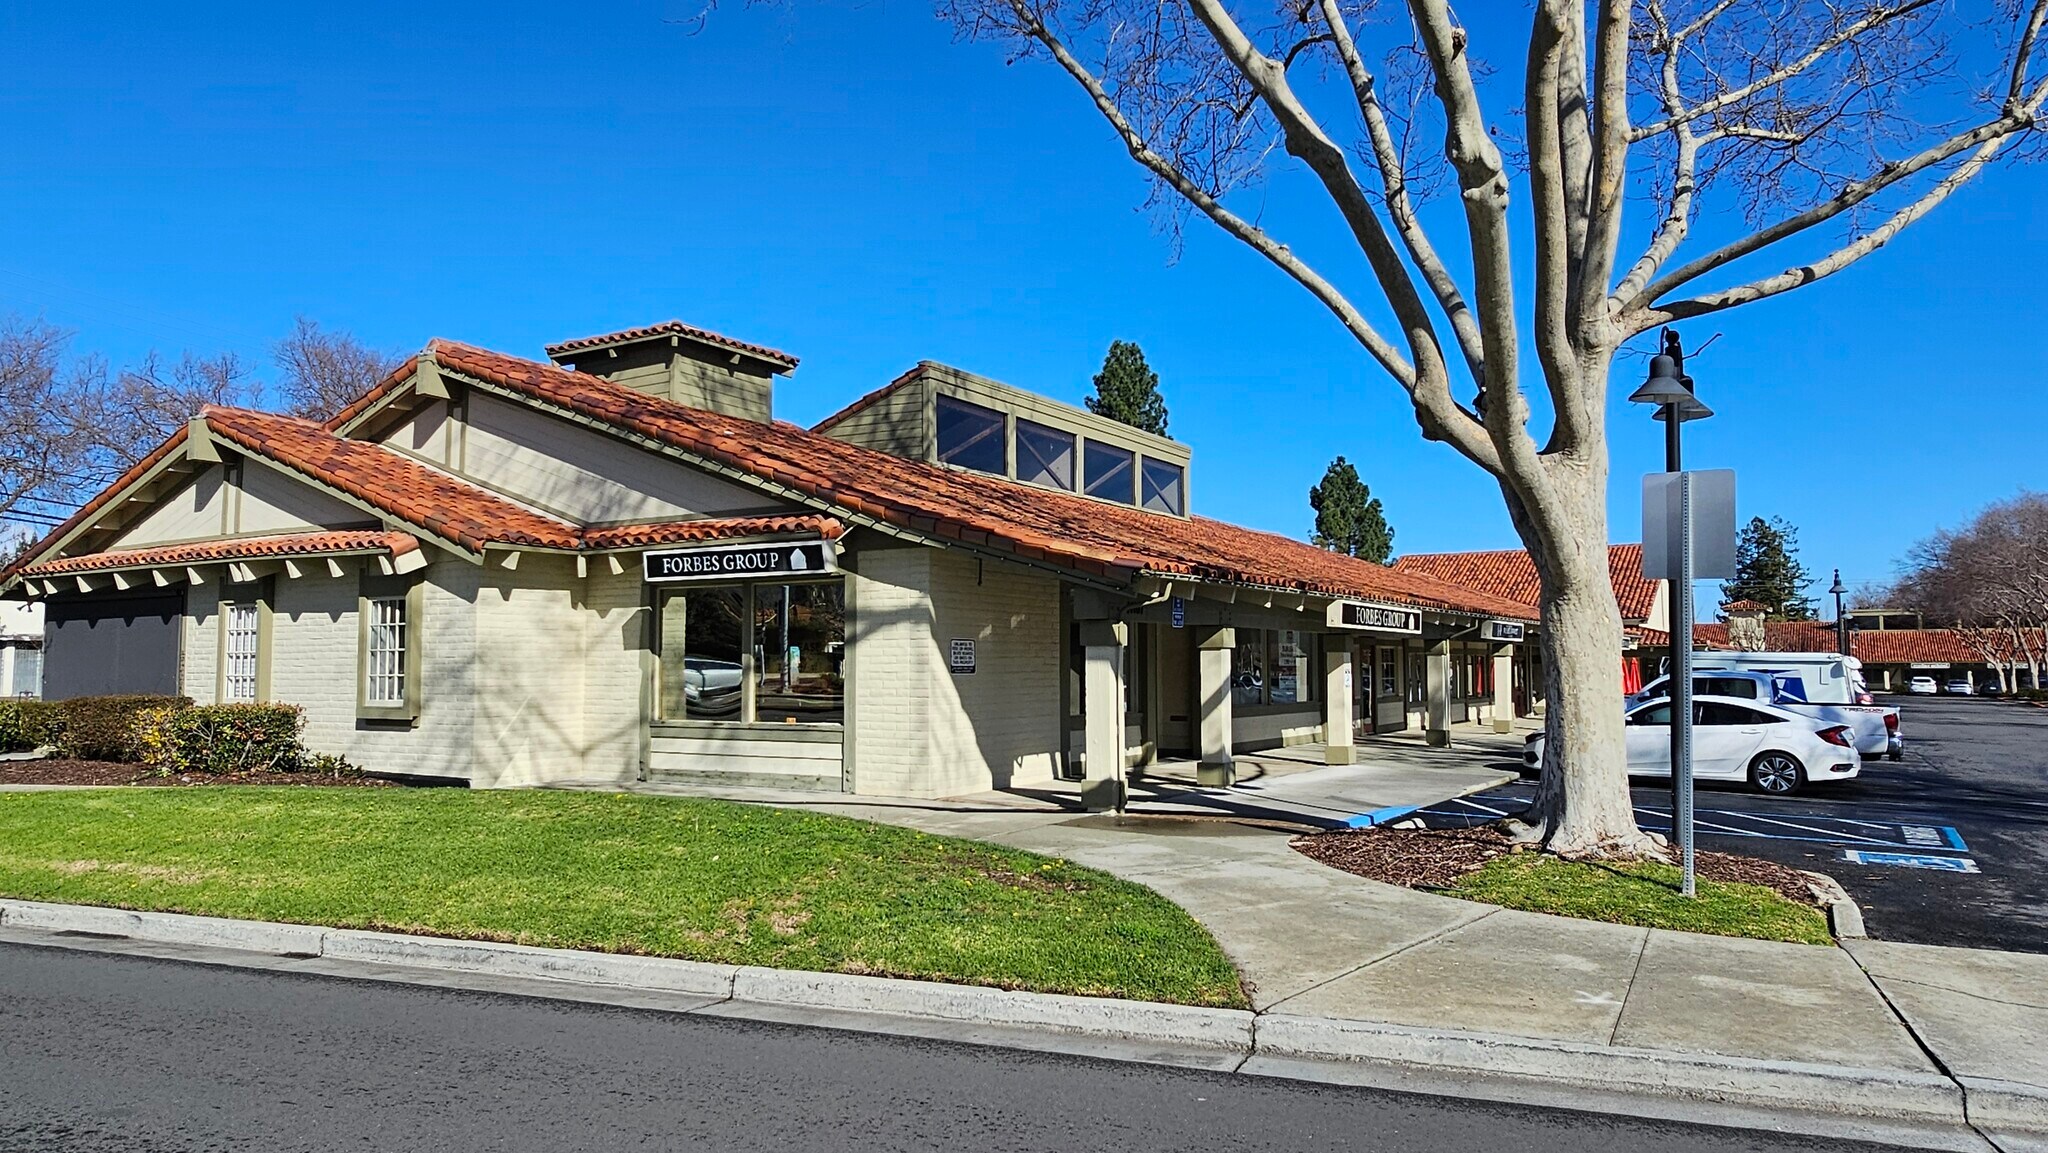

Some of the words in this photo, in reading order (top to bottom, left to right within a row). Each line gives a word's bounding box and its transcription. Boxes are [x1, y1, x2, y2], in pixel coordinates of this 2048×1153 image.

[662, 555, 720, 573] FORBES
[722, 552, 779, 570] GROUP
[1356, 607, 1382, 625] FORBES
[1382, 610, 1406, 628] GROUP
